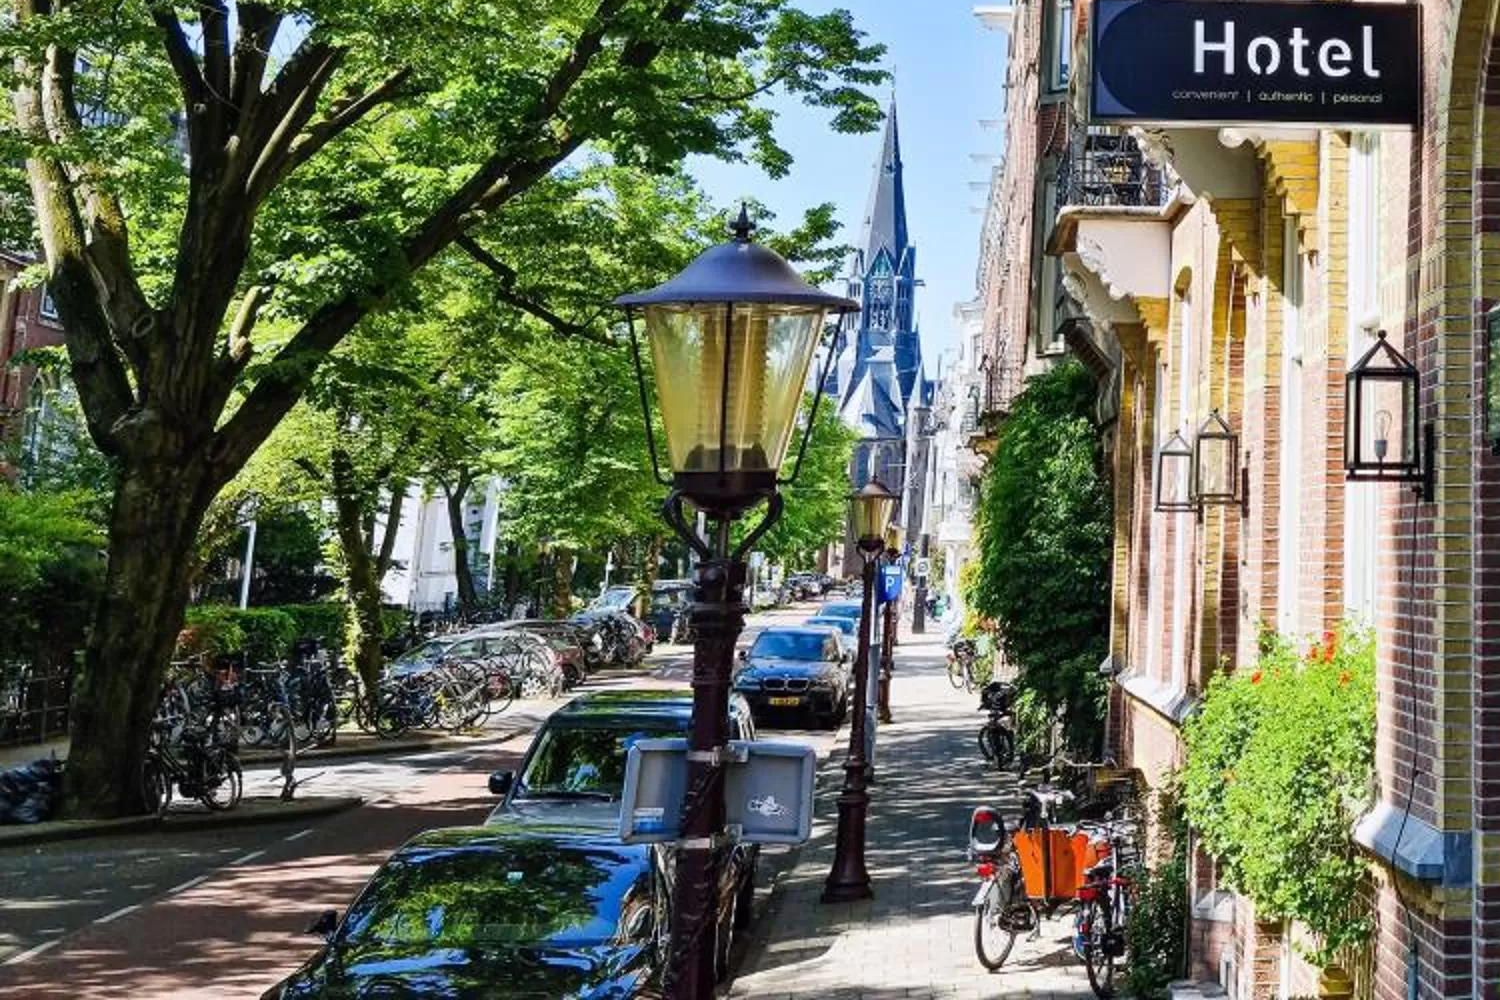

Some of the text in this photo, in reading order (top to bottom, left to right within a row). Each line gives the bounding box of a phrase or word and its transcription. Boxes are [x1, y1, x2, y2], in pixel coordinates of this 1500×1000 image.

[1193, 18, 1381, 79] Hotel
[1171, 89, 1383, 104] convenient authentic personal
[885, 574, 895, 593] P
